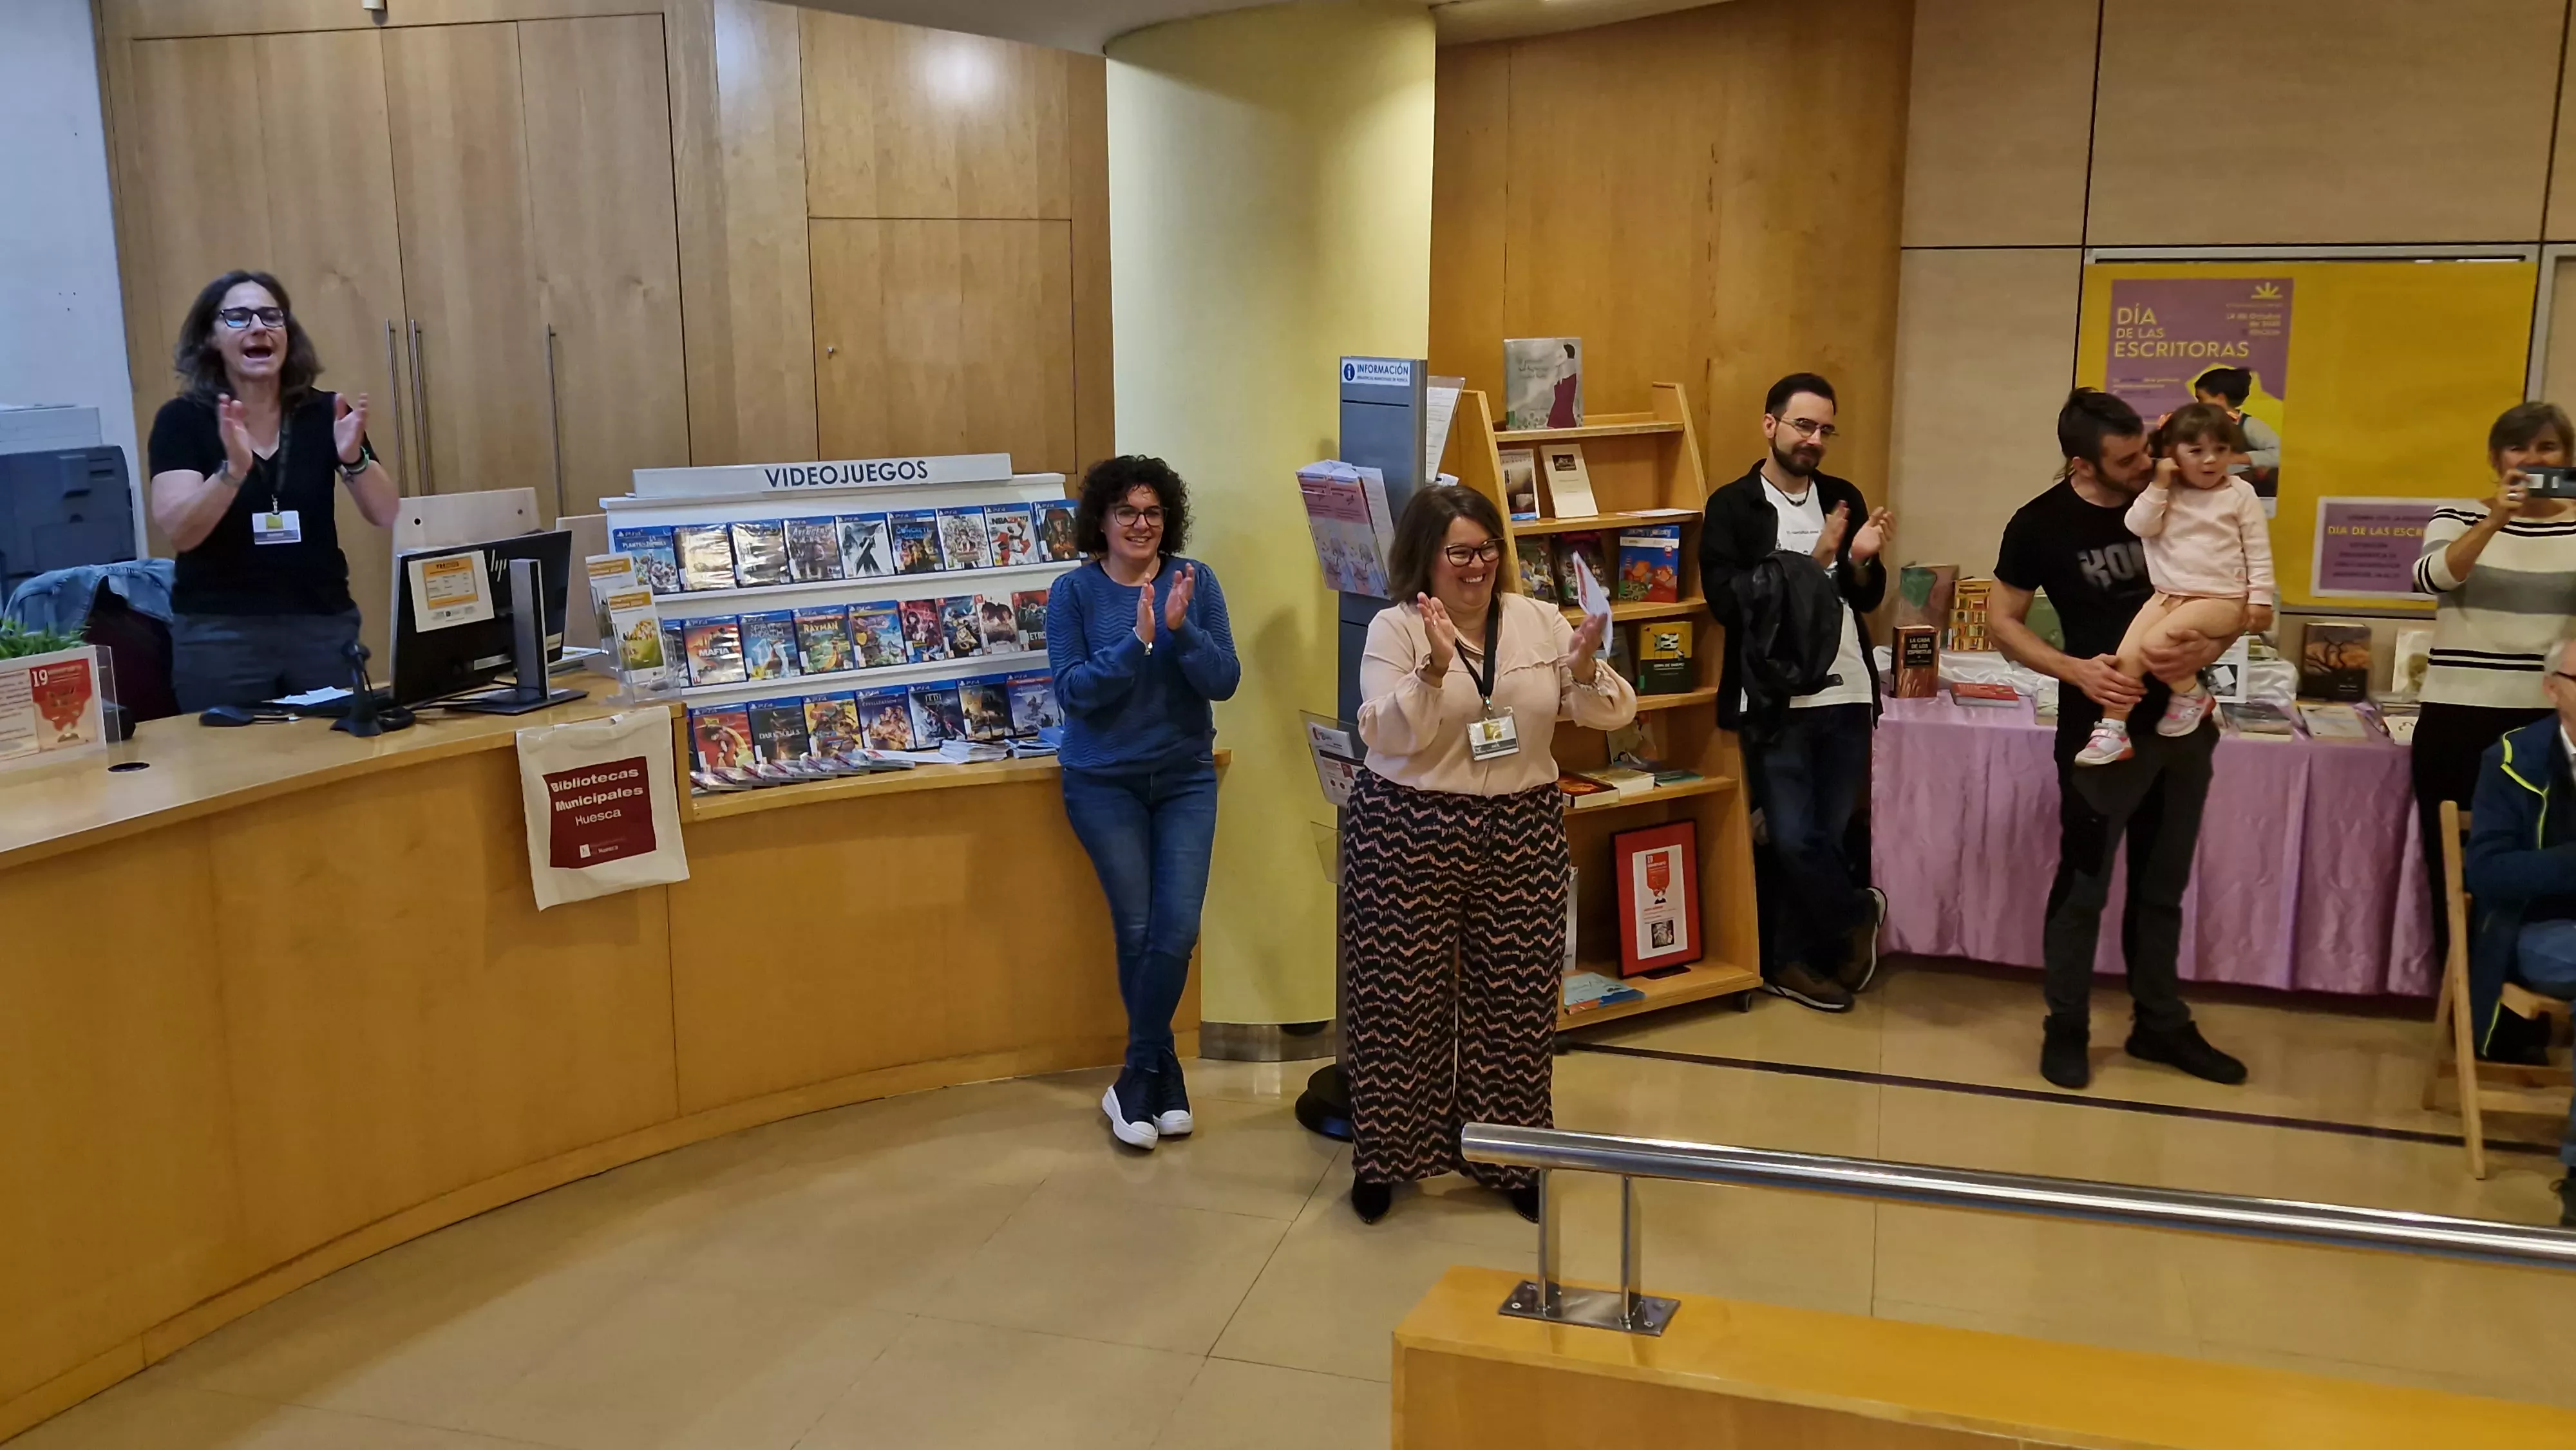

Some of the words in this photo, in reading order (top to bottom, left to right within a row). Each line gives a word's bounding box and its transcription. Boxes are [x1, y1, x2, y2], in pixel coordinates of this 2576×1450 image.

[2117, 303, 2157, 325] DÍA
[2116, 328, 2133, 339] DE
[2138, 328, 2165, 339] LAS
[2114, 341, 2250, 357] ESCRITORAS
[1357, 362, 1408, 375] INFORMACIÓN
[764, 460, 928, 487] VIDEOJUEGOS
[2353, 527, 2366, 535] DE
[2371, 527, 2389, 536] LAS
[803, 621, 838, 633] RAYMAN
[698, 647, 730, 657] MAFIA
[32, 670, 48, 687] 19
[925, 694, 942, 702] JEDI
[550, 768, 639, 793] Bibliotecas
[555, 786, 644, 812] Municipales
[575, 809, 621, 826] Huesca
